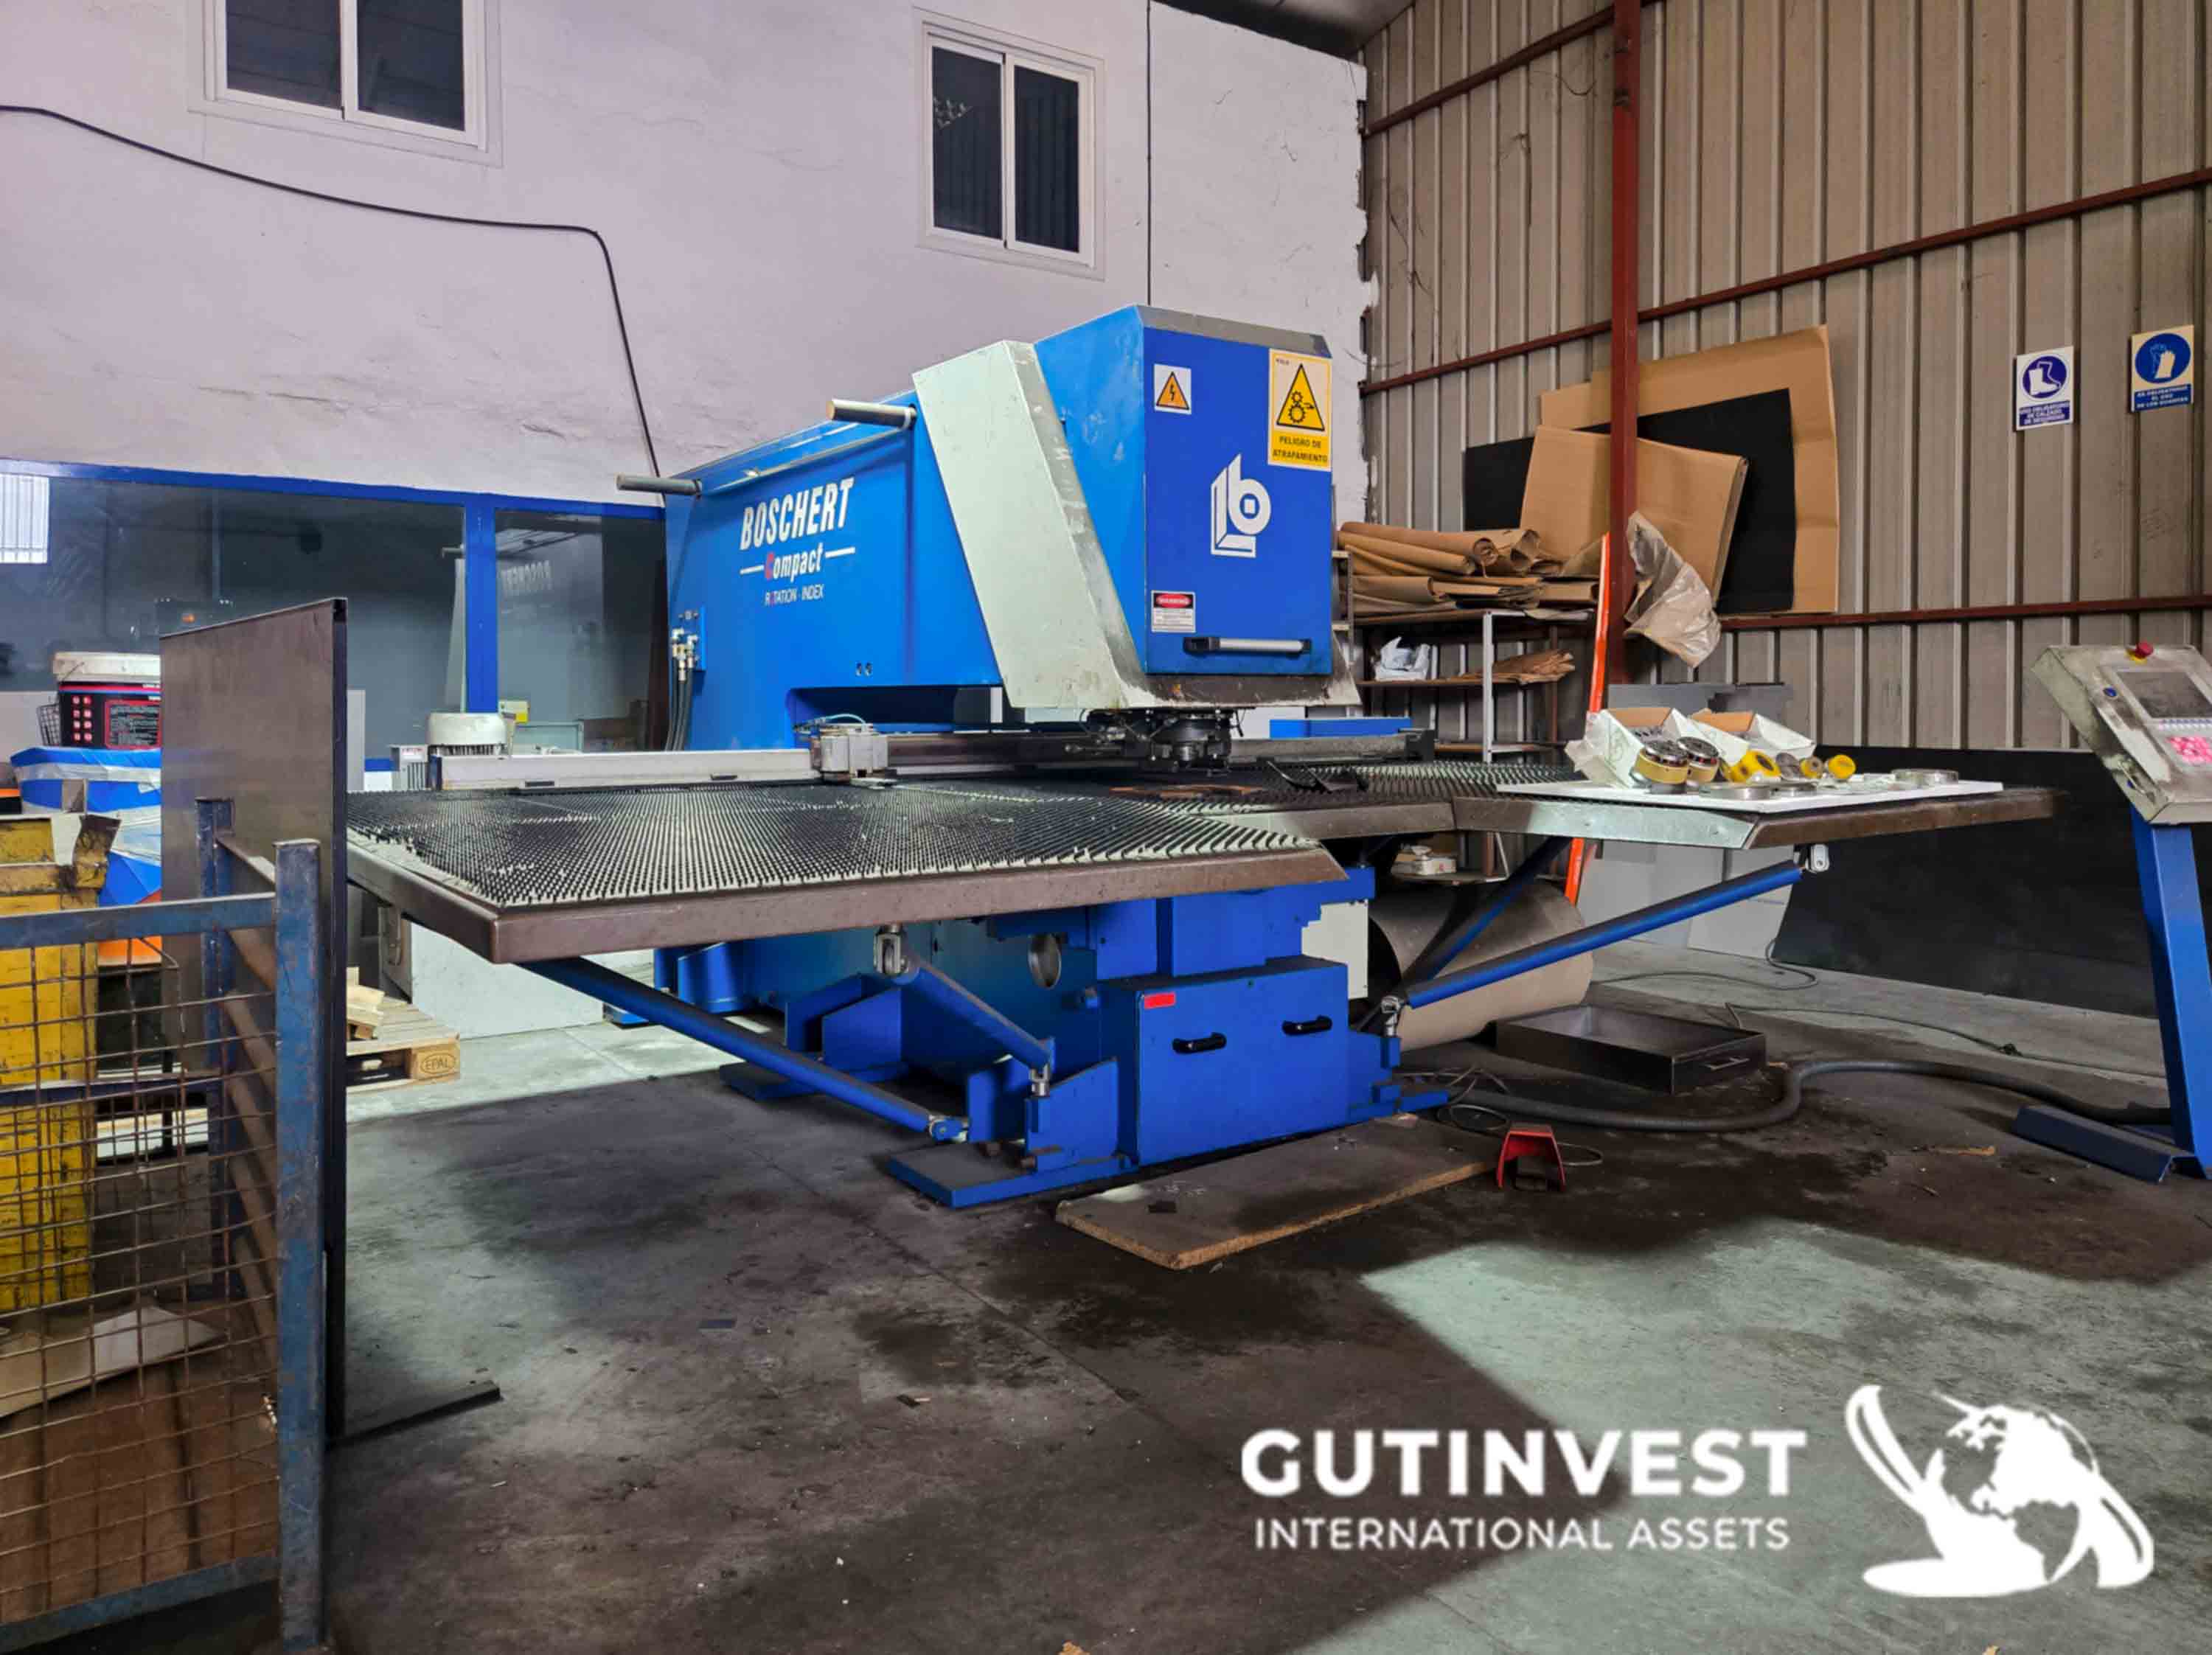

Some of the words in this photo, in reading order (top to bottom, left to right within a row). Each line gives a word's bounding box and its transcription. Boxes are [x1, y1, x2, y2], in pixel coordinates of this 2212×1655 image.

[1279, 435, 1310, 447] PELIGRO
[1312, 439, 1322, 449] DE
[1273, 449, 1328, 462] ATRAPAMIENTO
[740, 477, 855, 550] BOSCHERT
[765, 542, 823, 582] Compact
[801, 584, 824, 601] INDEX
[425, 1056, 448, 1070] EPAL
